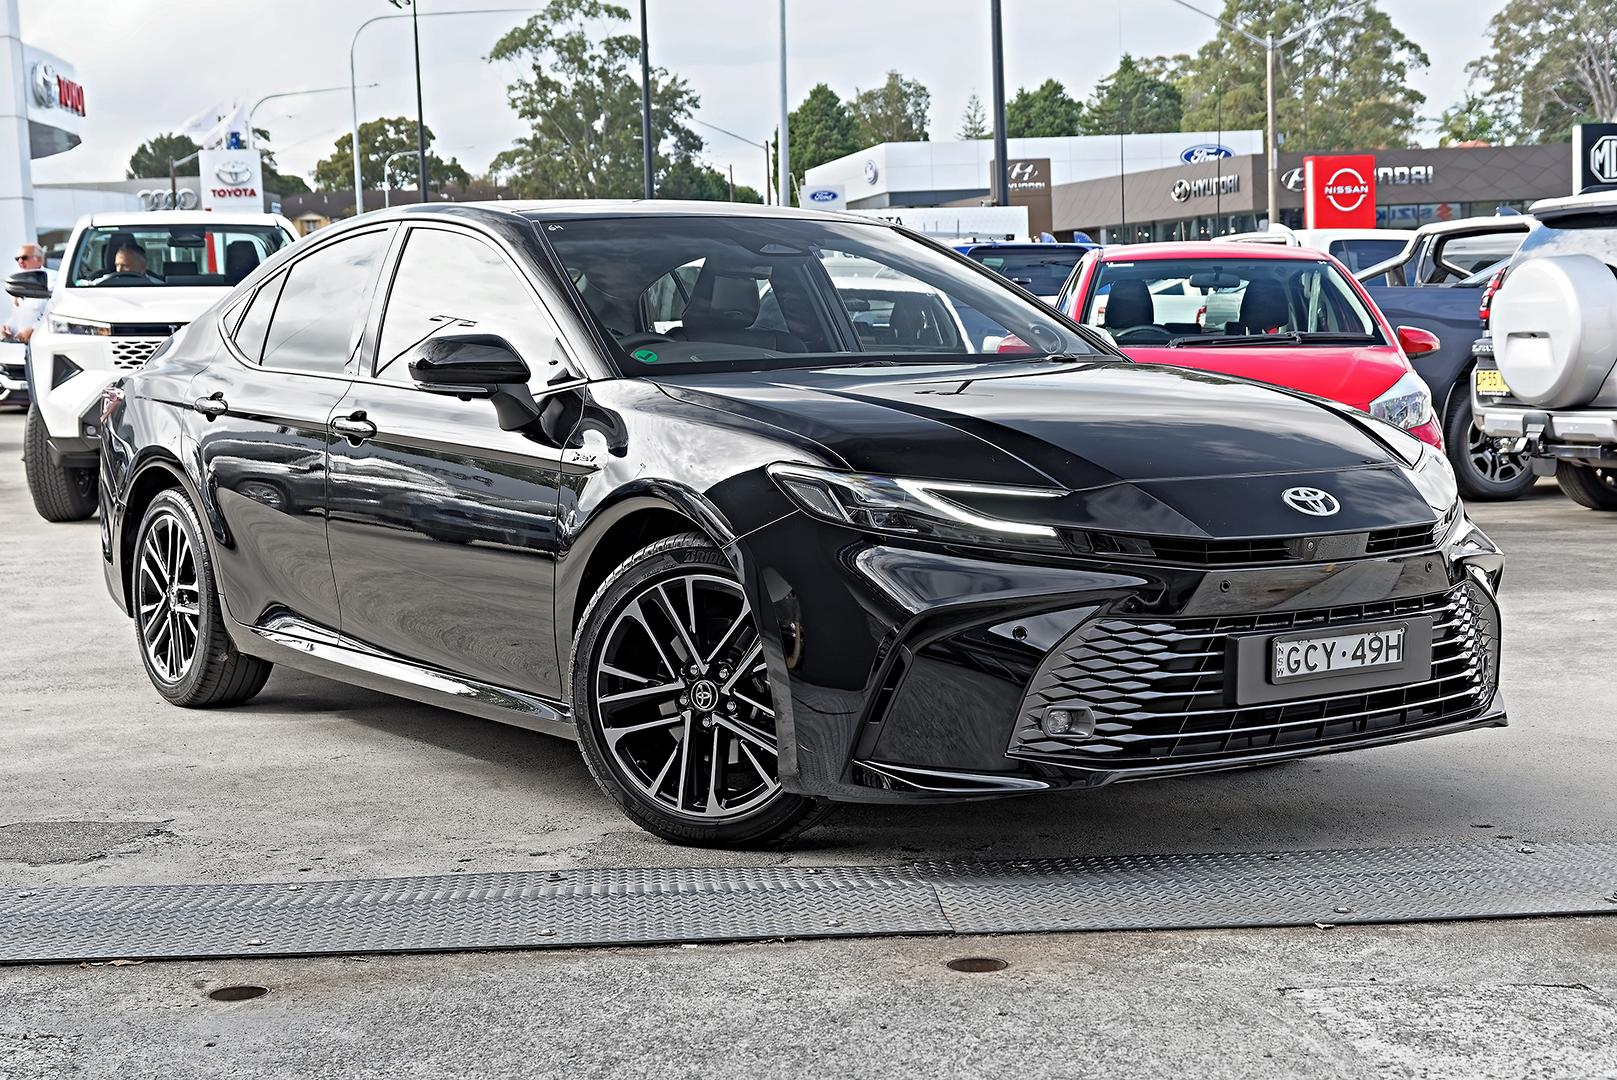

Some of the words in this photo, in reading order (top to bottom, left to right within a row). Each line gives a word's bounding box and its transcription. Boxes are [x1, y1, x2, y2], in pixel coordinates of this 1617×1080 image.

[1008, 182, 1046, 192] YUNDAI
[1191, 174, 1240, 197] HYUNDAI
[1324, 184, 1369, 195] NISSAN
[211, 188, 257, 198] TOYOTA
[814, 191, 836, 201] Ford
